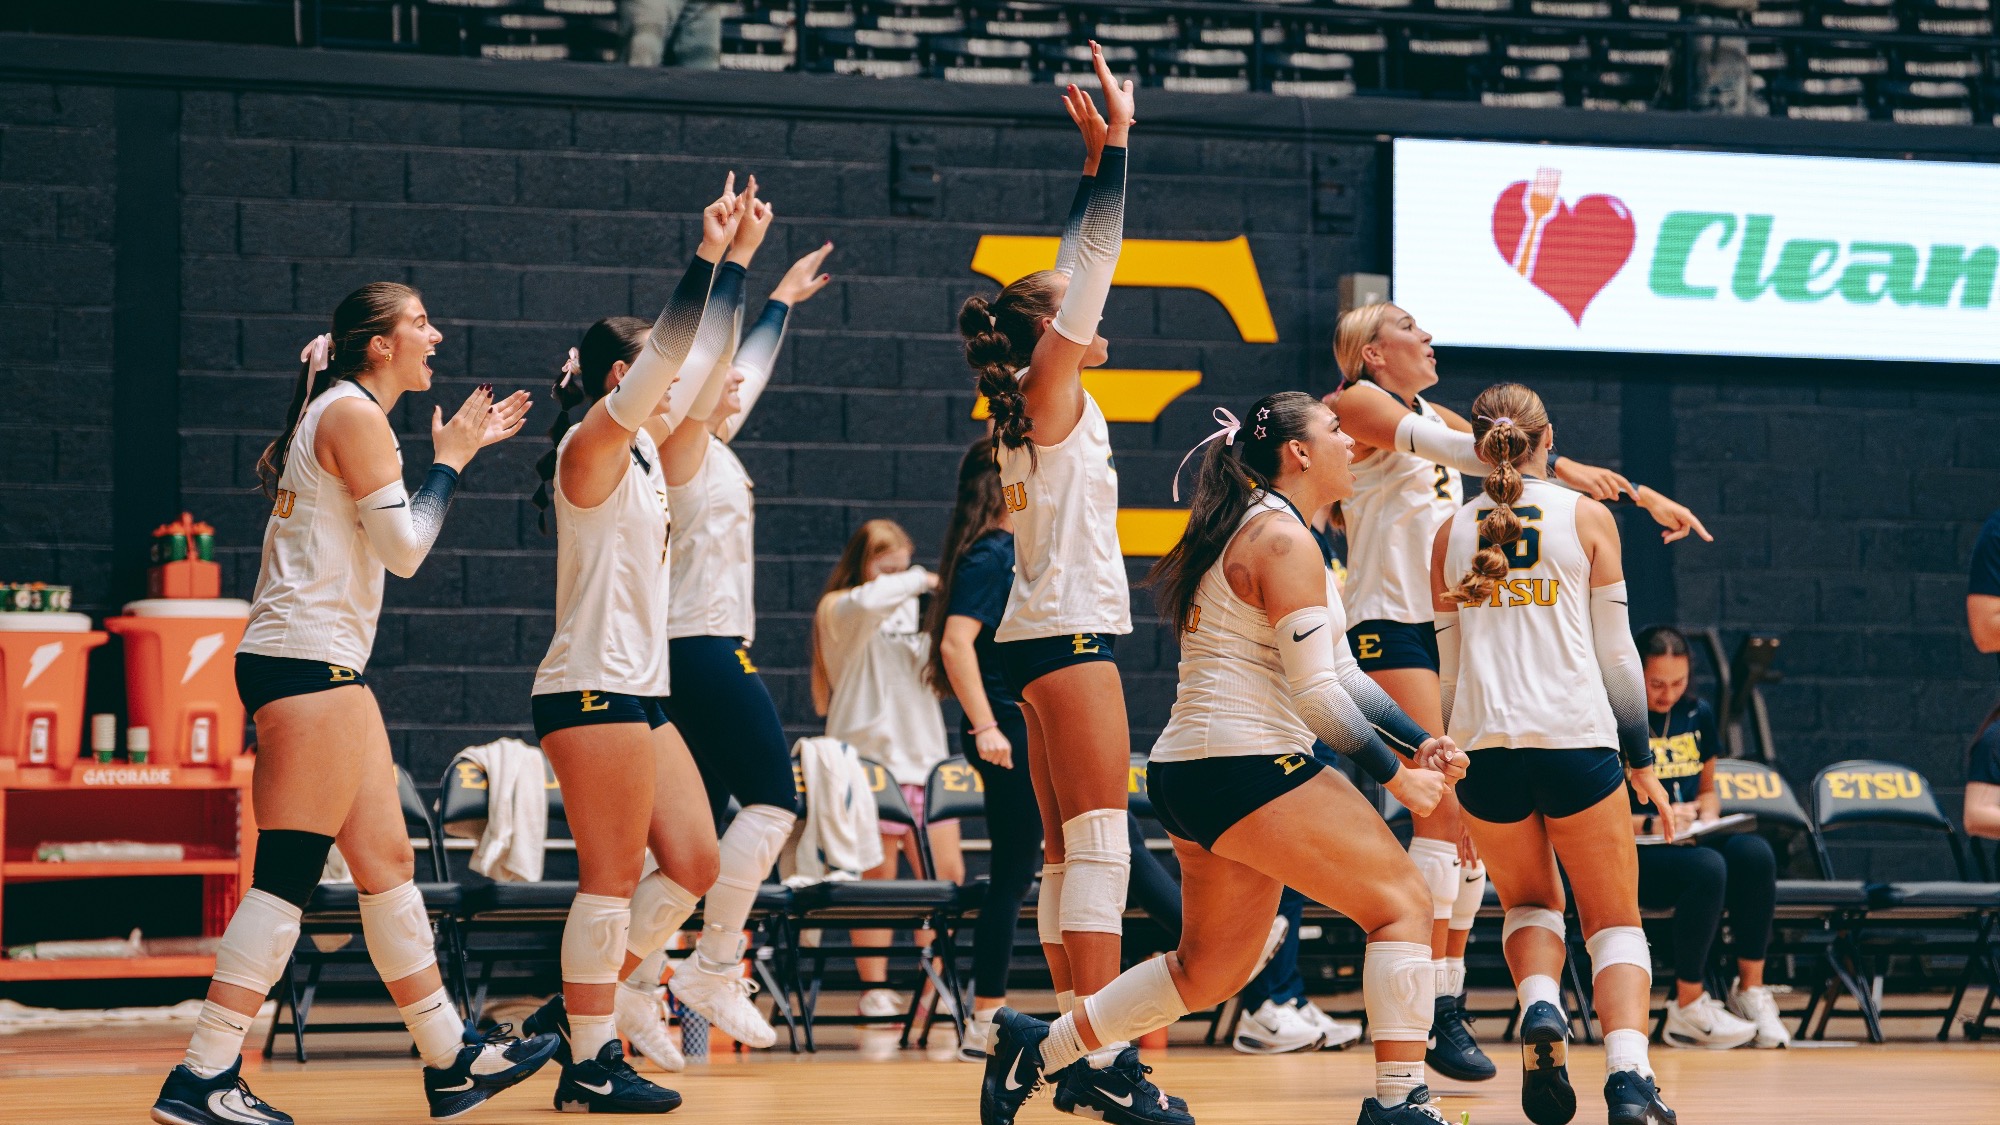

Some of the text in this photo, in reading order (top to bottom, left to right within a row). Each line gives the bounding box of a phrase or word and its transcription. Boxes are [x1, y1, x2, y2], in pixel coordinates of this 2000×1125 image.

[1648, 210, 1999, 309] Clean
[970, 235, 1280, 557] E
[1433, 464, 1452, 500] 2
[1463, 578, 1560, 608] TSU
[1357, 633, 1383, 659] E
[82, 768, 171, 785] GATORADE
[1714, 771, 1783, 800] TSU
[1824, 771, 1923, 799] ETSU
